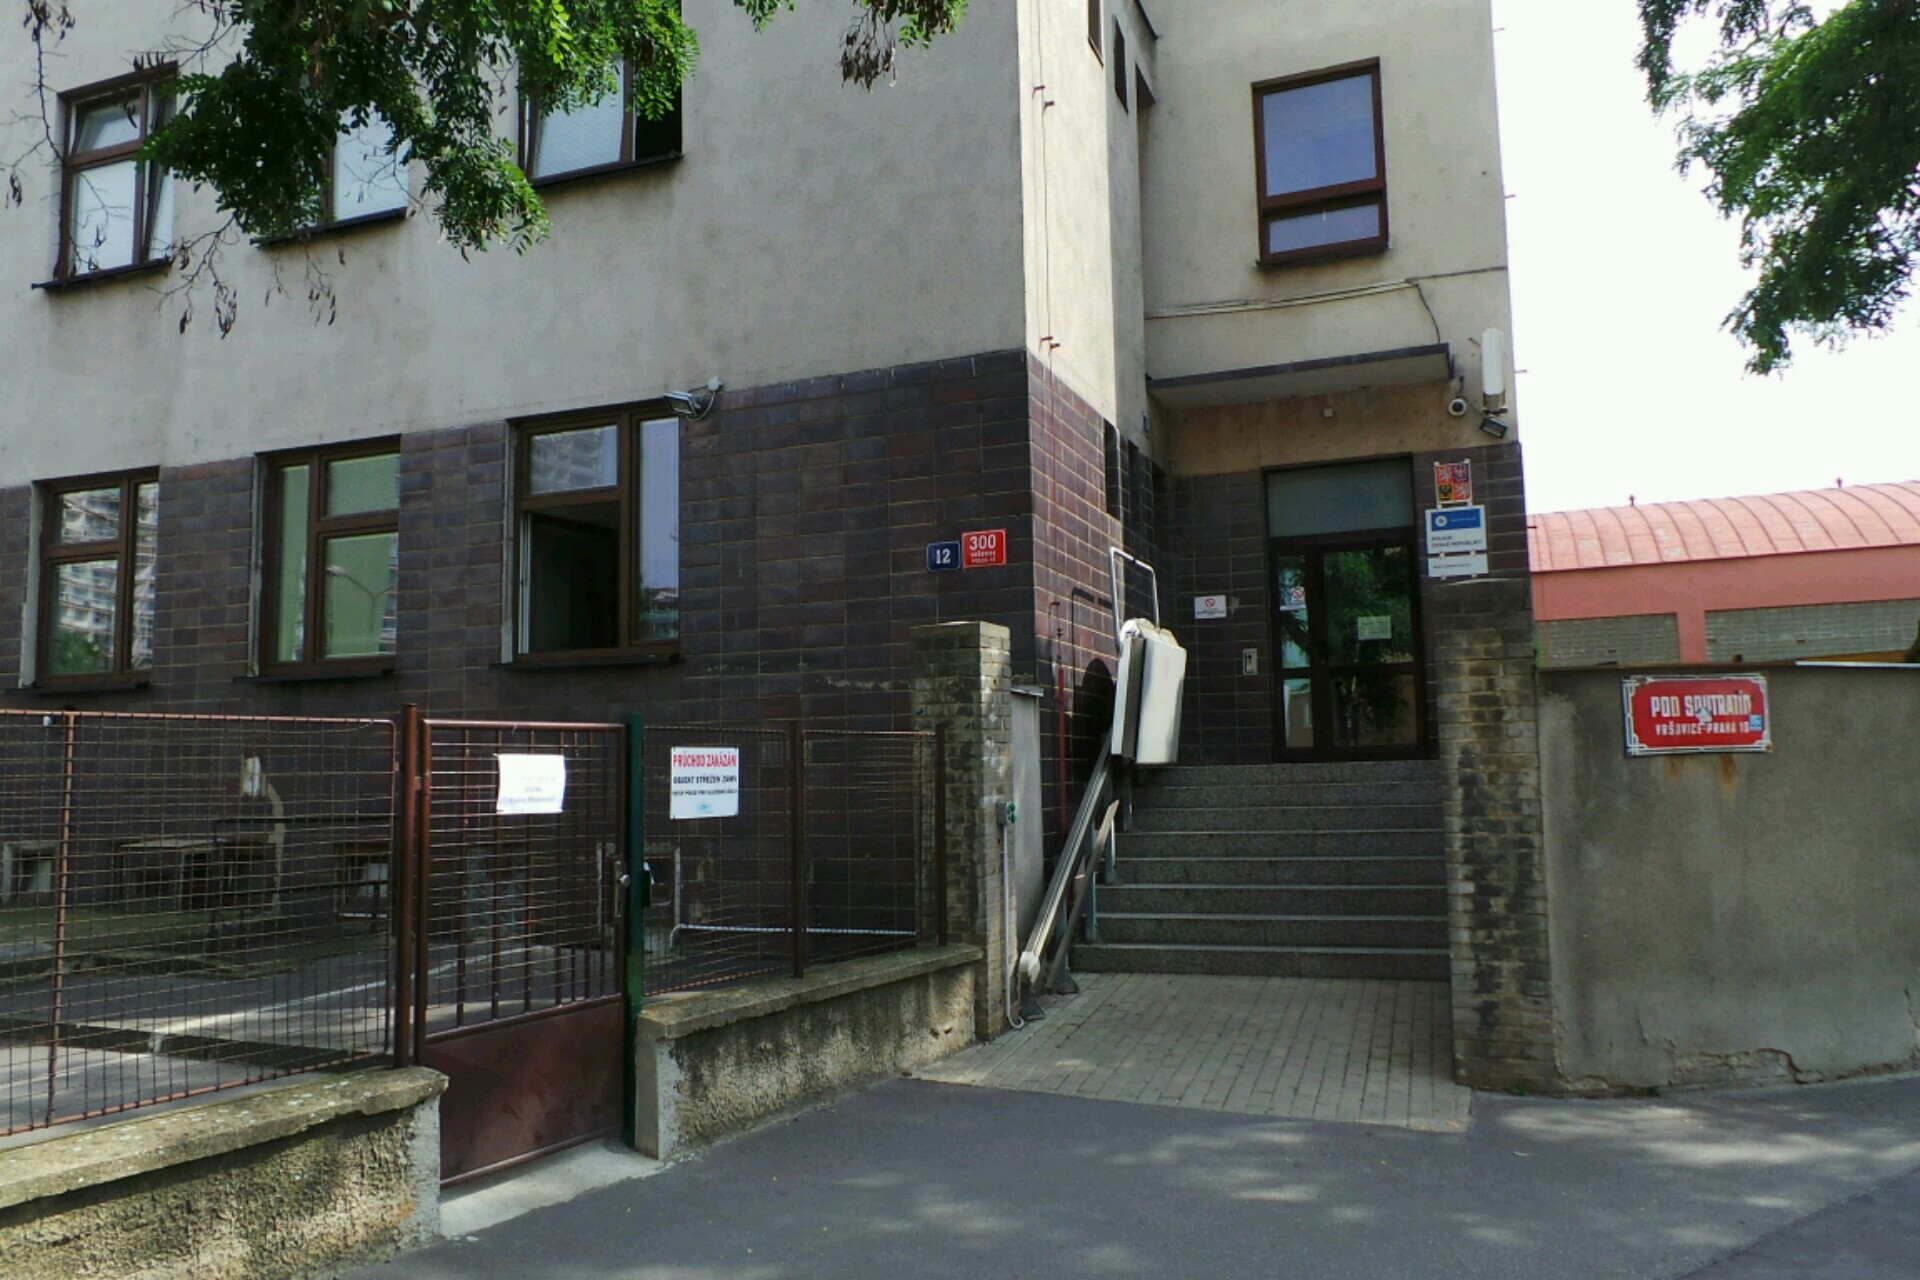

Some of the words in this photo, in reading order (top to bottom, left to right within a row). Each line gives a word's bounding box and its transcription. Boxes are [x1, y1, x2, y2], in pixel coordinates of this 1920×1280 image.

[969, 534, 996, 551] 300
[935, 548, 951, 564] 12
[1650, 695, 1681, 718] POD
